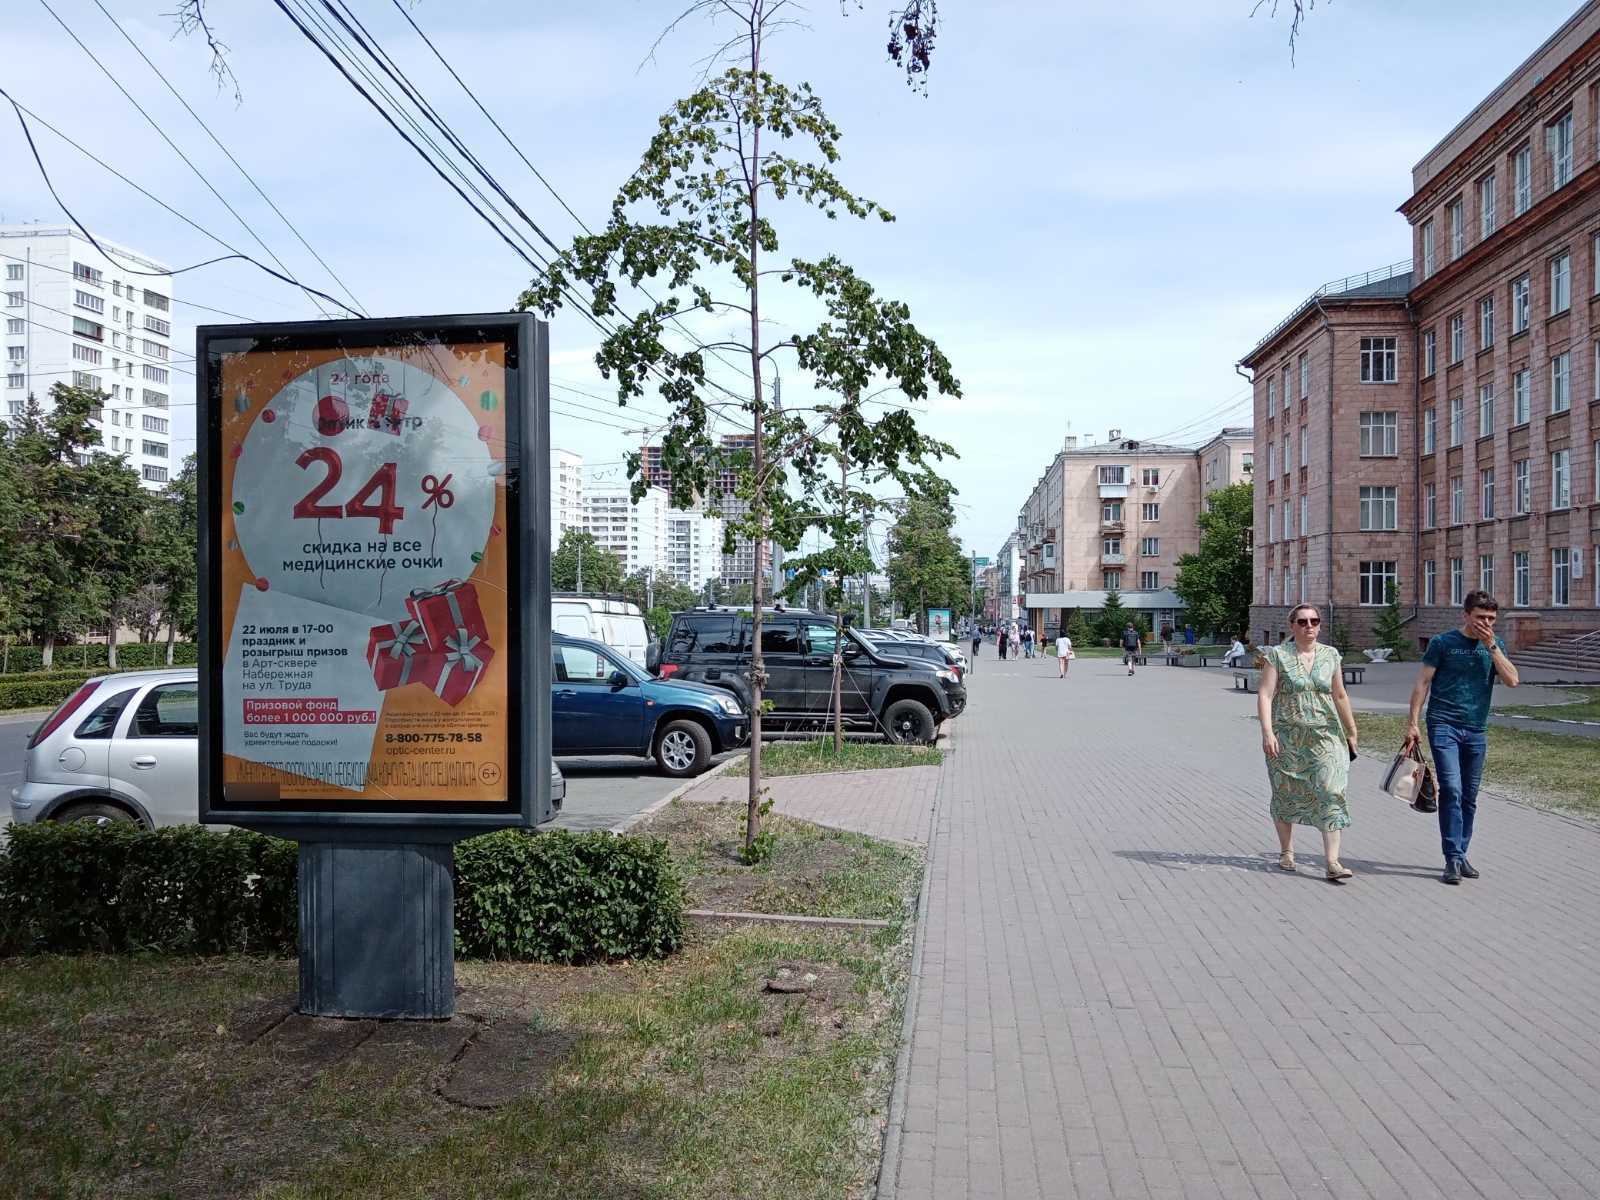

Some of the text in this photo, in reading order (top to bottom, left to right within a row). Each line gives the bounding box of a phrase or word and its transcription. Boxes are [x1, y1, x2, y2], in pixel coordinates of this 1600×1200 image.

[354, 373, 390, 385] года
[293, 446, 455, 535] 24 %
[303, 540, 422, 555] скидка на все
[282, 557, 443, 572] медицинские очки
[242, 624, 334, 634] 22 июля в 17-00
[242, 637, 306, 647] праздник и
[242, 648, 348, 658] розыгрыш призов
[242, 659, 318, 670] в Арт-сквере
[242, 669, 313, 680] Набережная
[242, 682, 256, 690] на
[279, 680, 312, 691] Труда
[246, 699, 337, 711] Призовой фонд
[246, 712, 281, 722] более
[292, 712, 316, 722] 000
[319, 712, 343, 722] 000
[347, 711, 376, 724] руб.!
[482, 769, 497, 779] 6+
